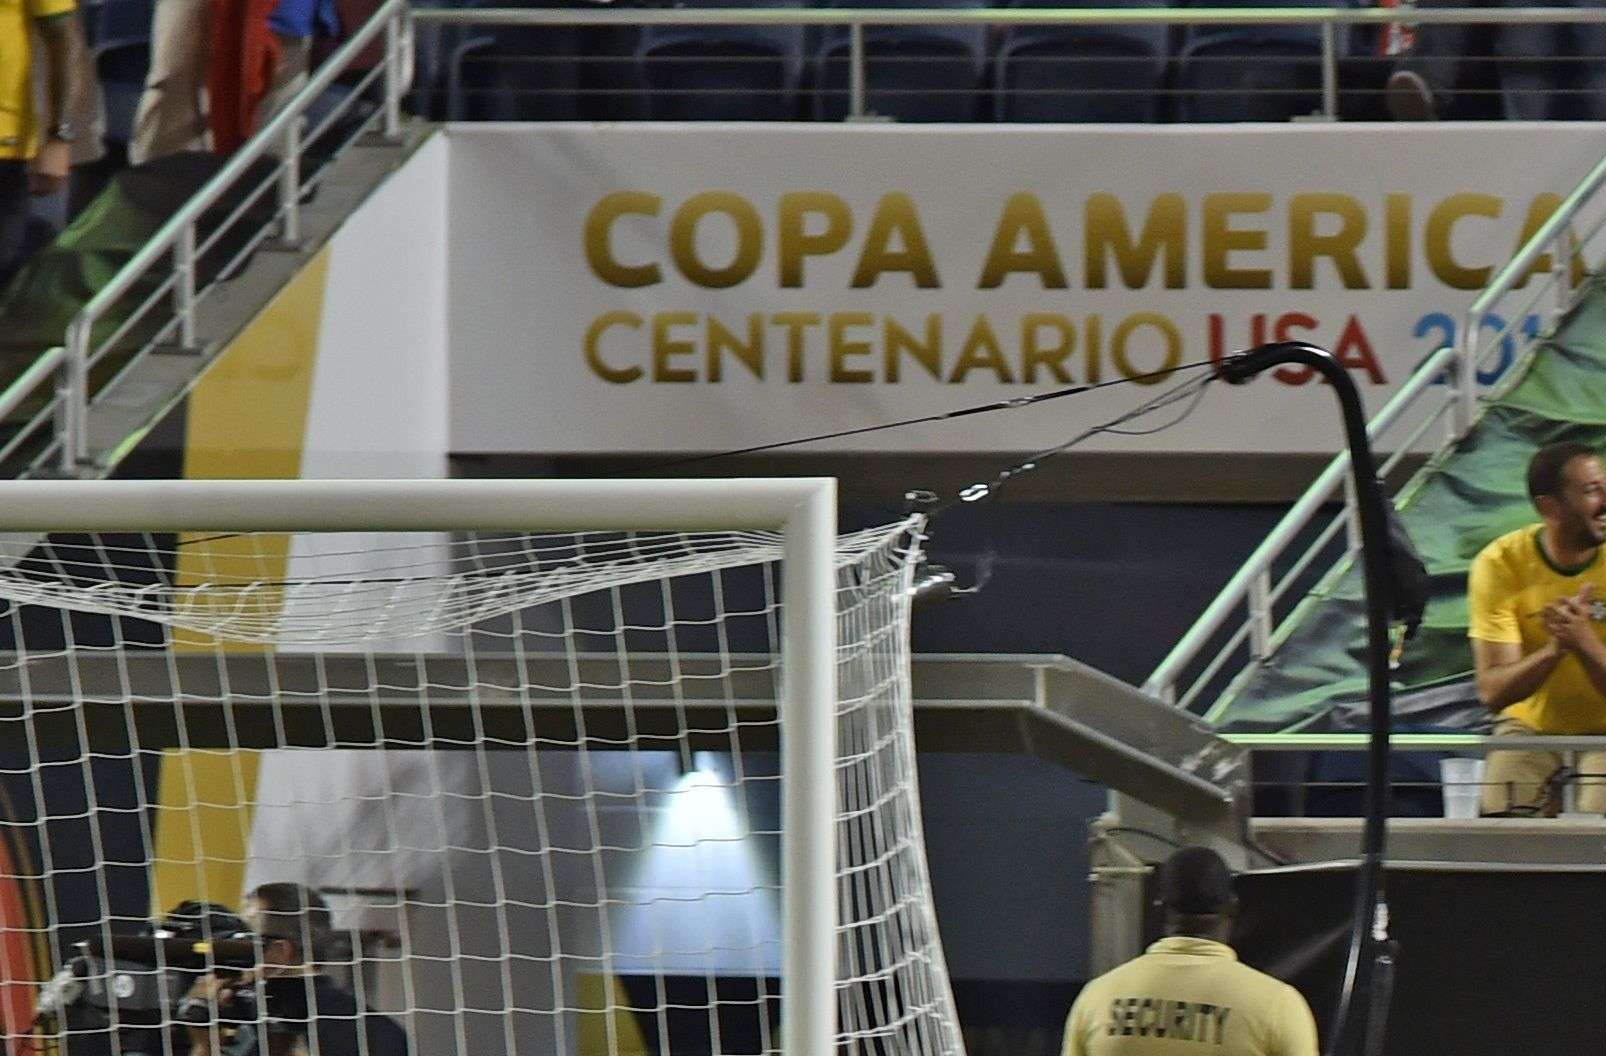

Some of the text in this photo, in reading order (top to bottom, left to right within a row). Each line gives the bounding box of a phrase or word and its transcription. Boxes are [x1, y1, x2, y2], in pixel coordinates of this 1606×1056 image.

[583, 190, 938, 290] COPA
[583, 311, 1185, 386] CENTENARIO
[1207, 311, 1389, 386] USA
[1106, 998, 1233, 1046] SECURITY
